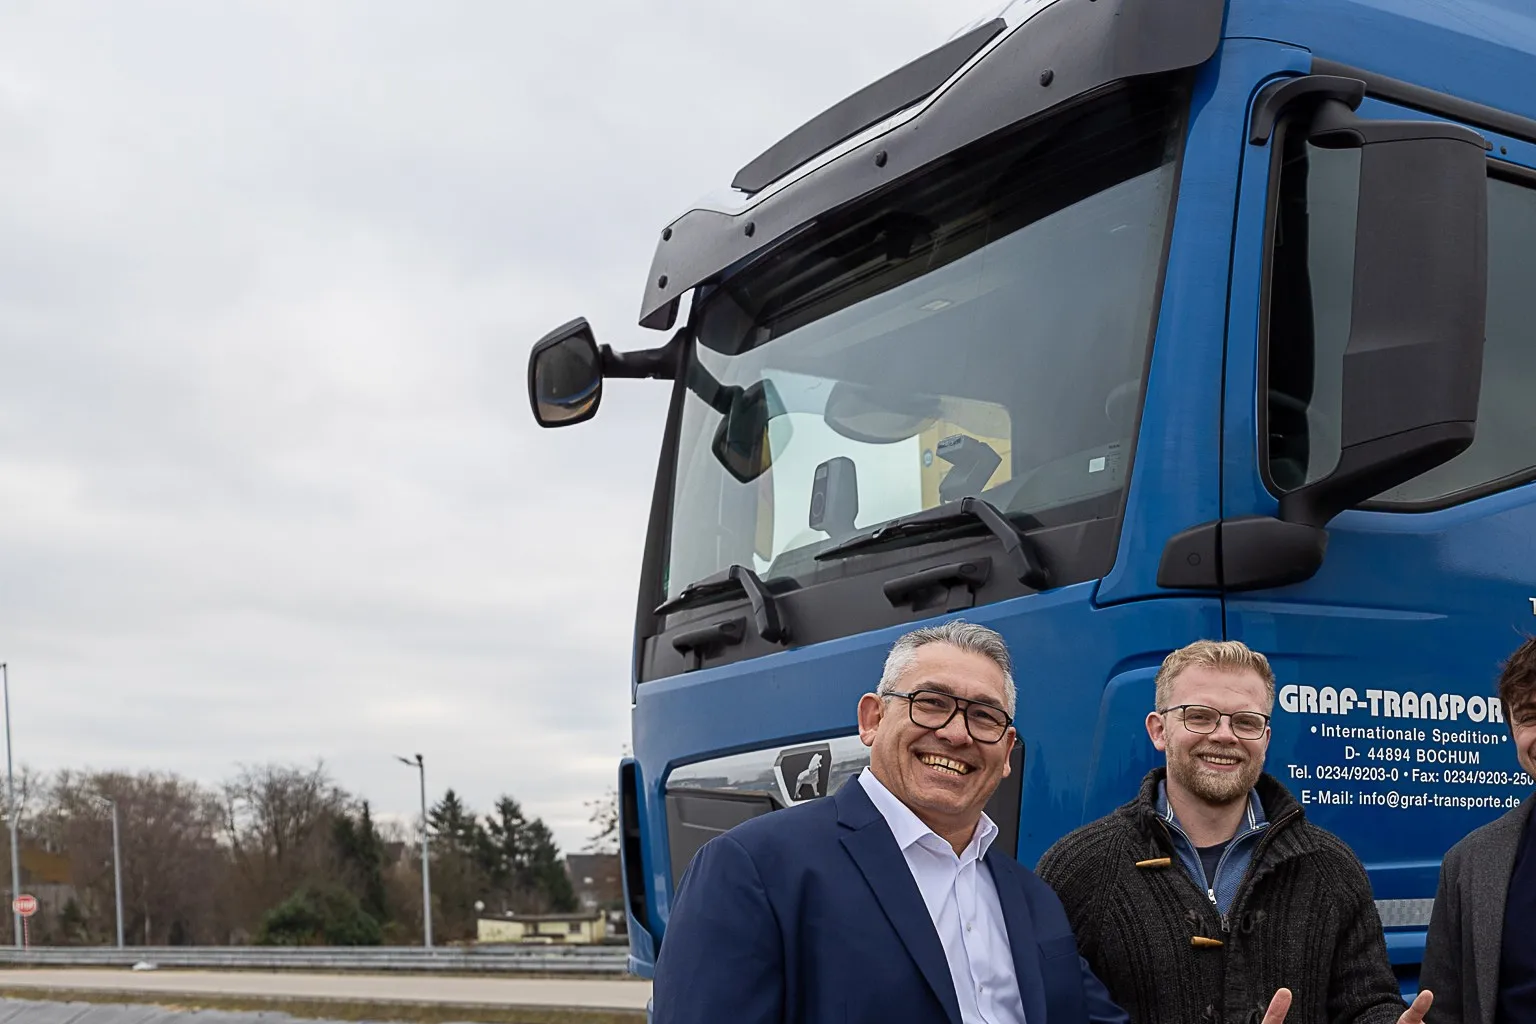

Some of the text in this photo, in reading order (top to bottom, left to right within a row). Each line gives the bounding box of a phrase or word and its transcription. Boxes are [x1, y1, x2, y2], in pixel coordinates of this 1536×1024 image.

[1278, 684, 1504, 723] GRAF-TRANSPOR
[1321, 723, 1499, 745] Internationale Spedition
[1345, 746, 1480, 765] D- 44894 BOCHUM
[1287, 764, 1312, 779] Tel.
[1316, 765, 1399, 781] 0234/9203-0
[1412, 768, 1440, 783] Fax:
[1301, 790, 1521, 811] E-Mail: info@graf-transporte.de
